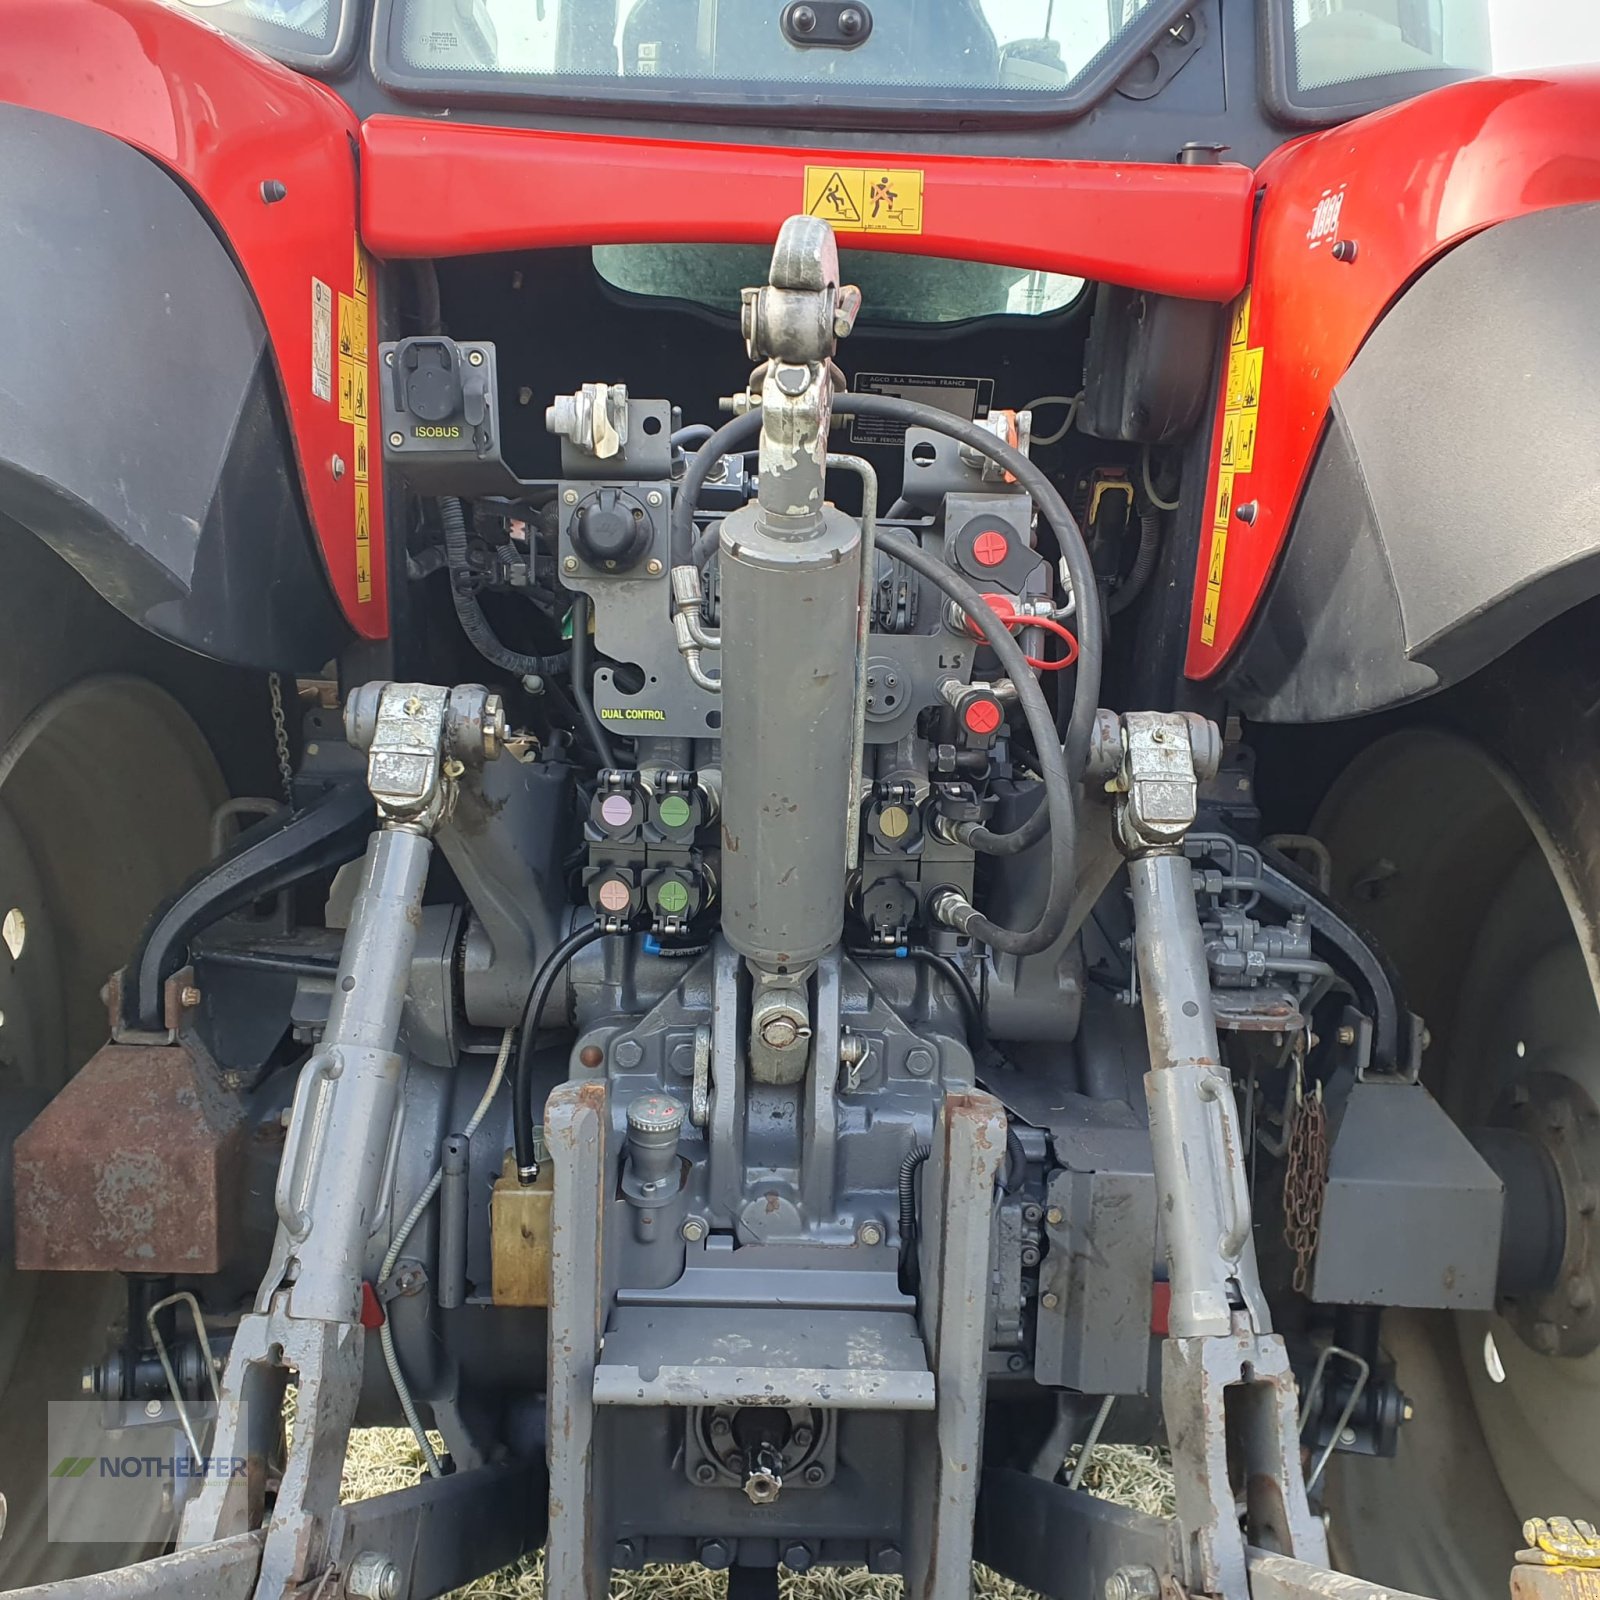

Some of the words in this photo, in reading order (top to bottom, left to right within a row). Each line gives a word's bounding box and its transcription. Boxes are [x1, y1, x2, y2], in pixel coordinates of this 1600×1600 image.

[415, 426, 460, 438] ISOBUS
[601, 709, 624, 719] DUAL
[625, 709, 665, 720] CONTROL
